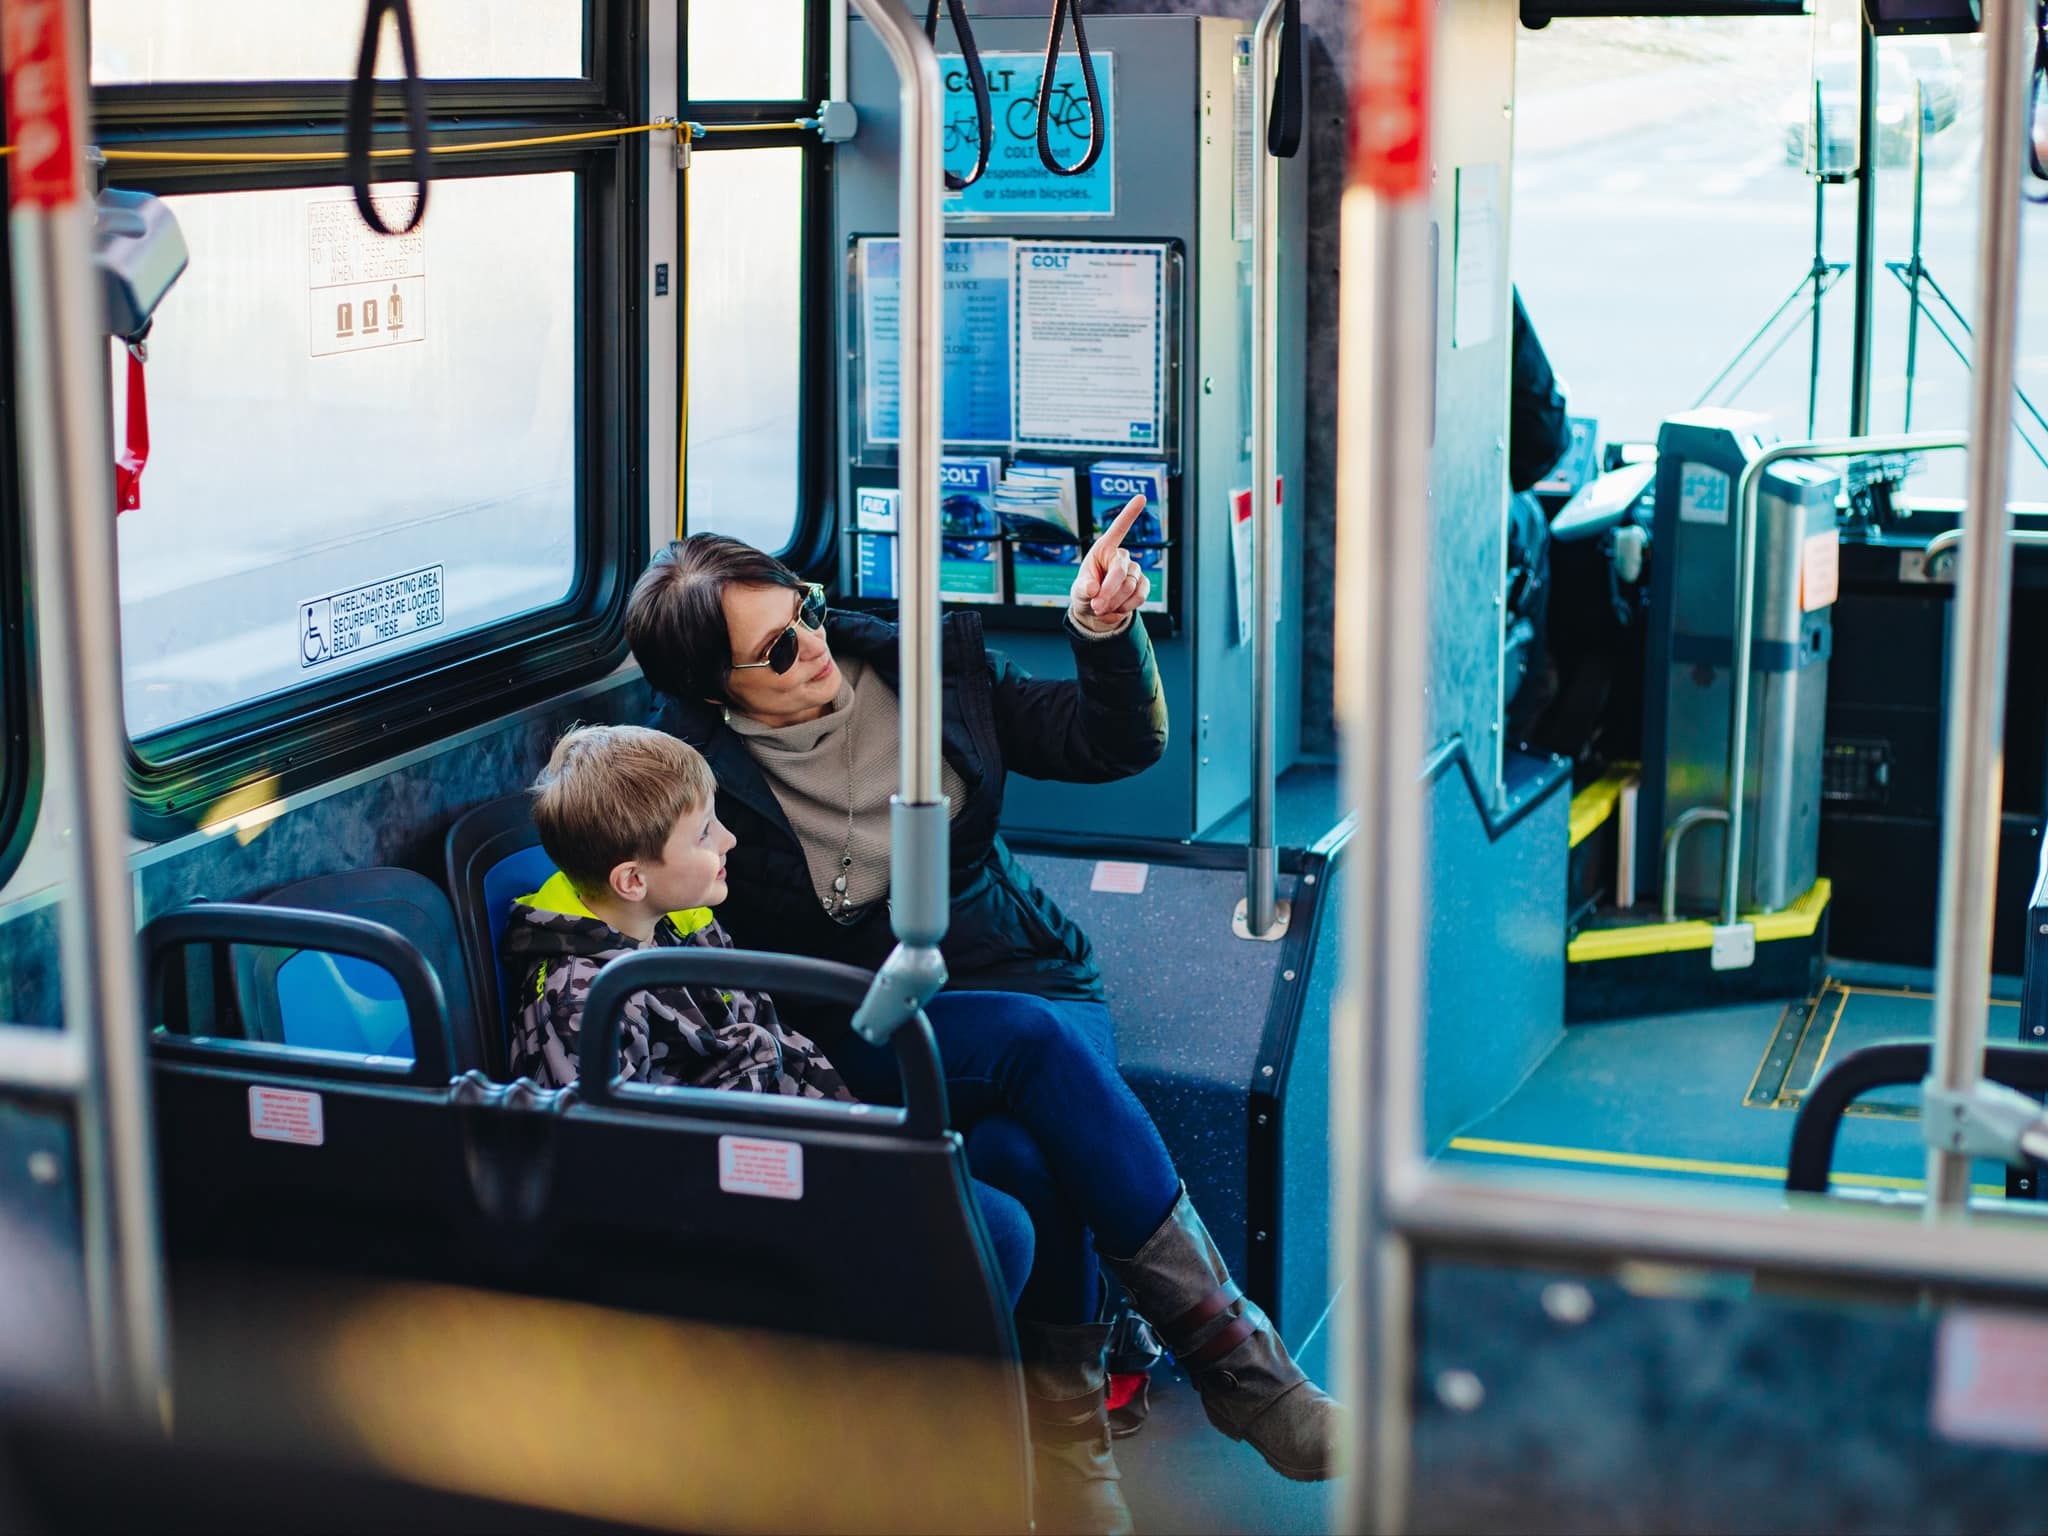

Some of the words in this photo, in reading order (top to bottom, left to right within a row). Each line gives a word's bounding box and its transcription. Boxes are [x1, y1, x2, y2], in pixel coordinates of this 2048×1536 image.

[1004, 147, 1034, 159] COLT
[985, 168, 1049, 182] esponsible
[984, 188, 997, 199] or
[1002, 187, 1036, 199] stolen
[1040, 186, 1092, 202] bicycles.
[1032, 255, 1069, 267] COLT
[1101, 477, 1148, 493] COLT
[333, 588, 383, 615] WHEELCHAIR
[385, 578, 416, 600] SEATING
[418, 571, 439, 591] AREA.
[333, 604, 389, 634] SECUREMENTS
[391, 598, 406, 617] ARE
[407, 588, 440, 612] LOCATED
[333, 631, 361, 653] BELOW
[374, 619, 399, 640] THESE
[416, 606, 441, 627] SEATS.
